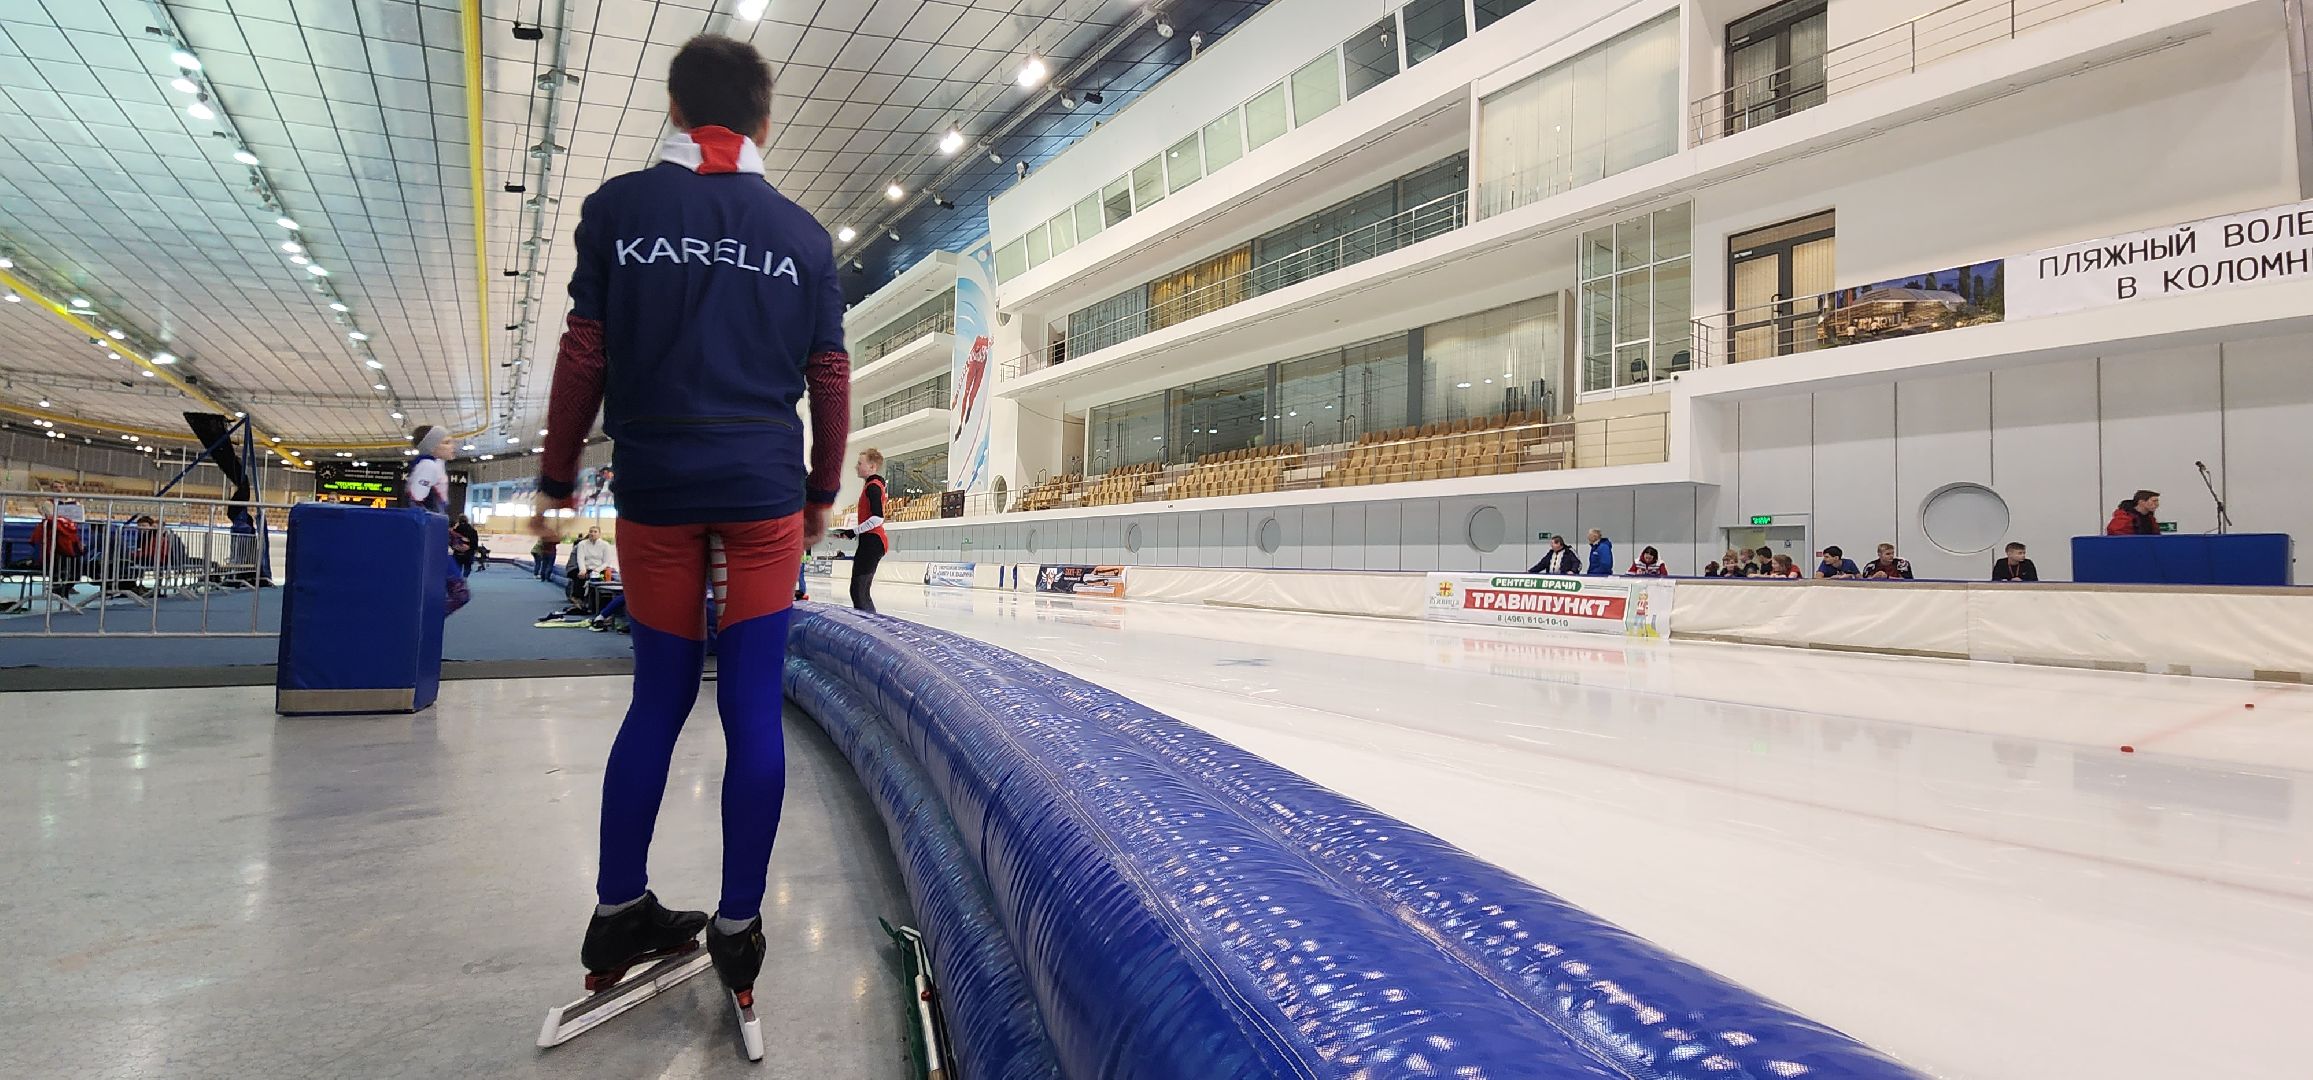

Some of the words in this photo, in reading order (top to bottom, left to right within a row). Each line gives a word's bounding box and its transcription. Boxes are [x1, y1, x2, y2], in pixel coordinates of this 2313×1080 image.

[615, 237, 799, 286] KARELIA
[2039, 226, 2196, 280] ПЛЯЖНЫЙ
[2117, 276, 2137, 300] В
[2163, 247, 2313, 293] КОЛОМН
[1472, 592, 1610, 617] ТРАВМПУНКТ
[1496, 578, 1537, 588] РЕНТГЕН
[1542, 580, 1577, 591] ВРАЧИ
